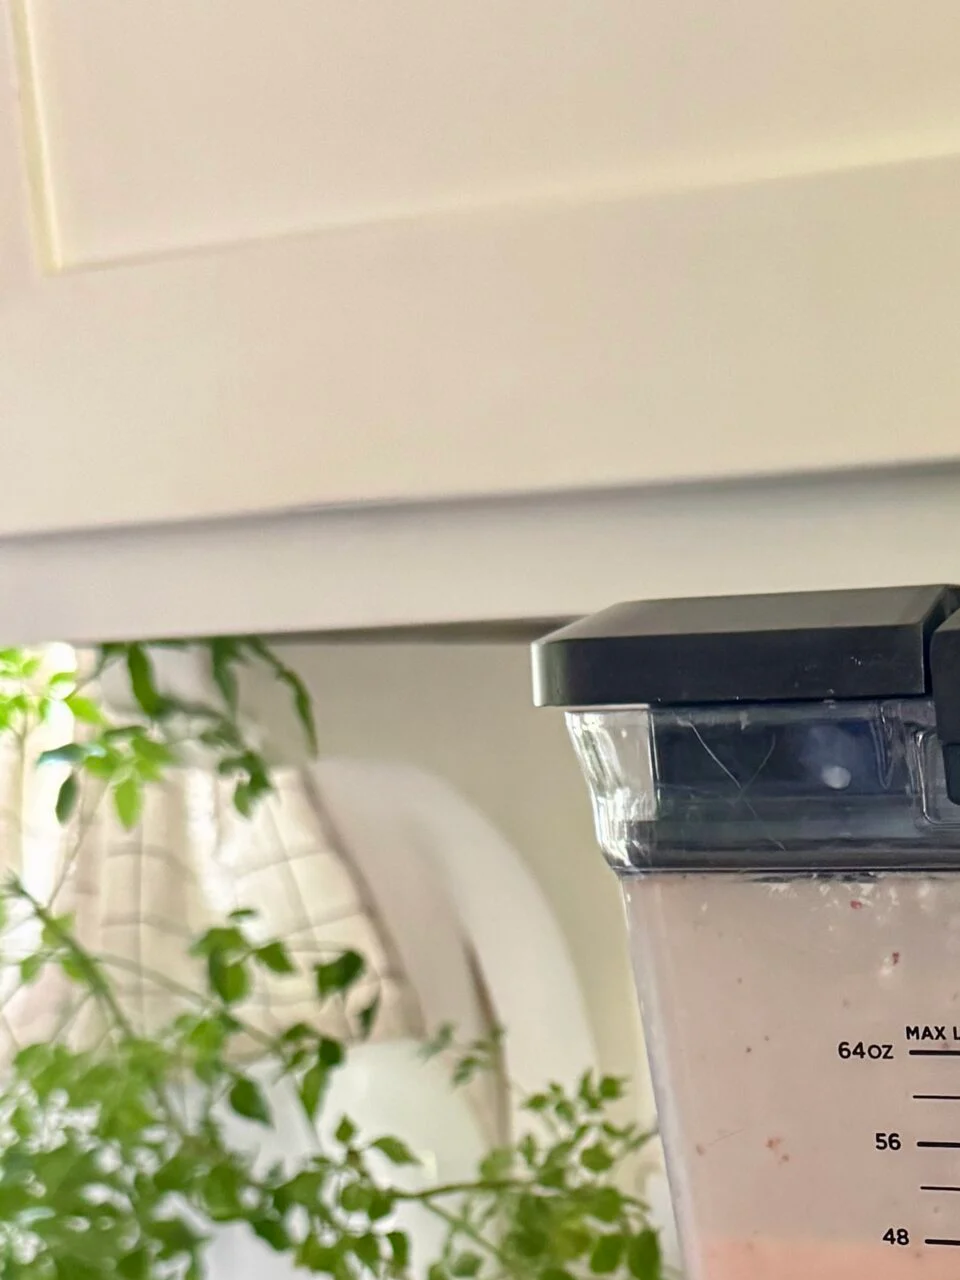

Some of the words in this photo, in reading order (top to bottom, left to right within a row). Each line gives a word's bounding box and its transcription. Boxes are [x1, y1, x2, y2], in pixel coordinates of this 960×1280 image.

[905, 1025, 947, 1041] MAX
[875, 1132, 902, 1151] 56
[882, 1227, 910, 1246] 48
